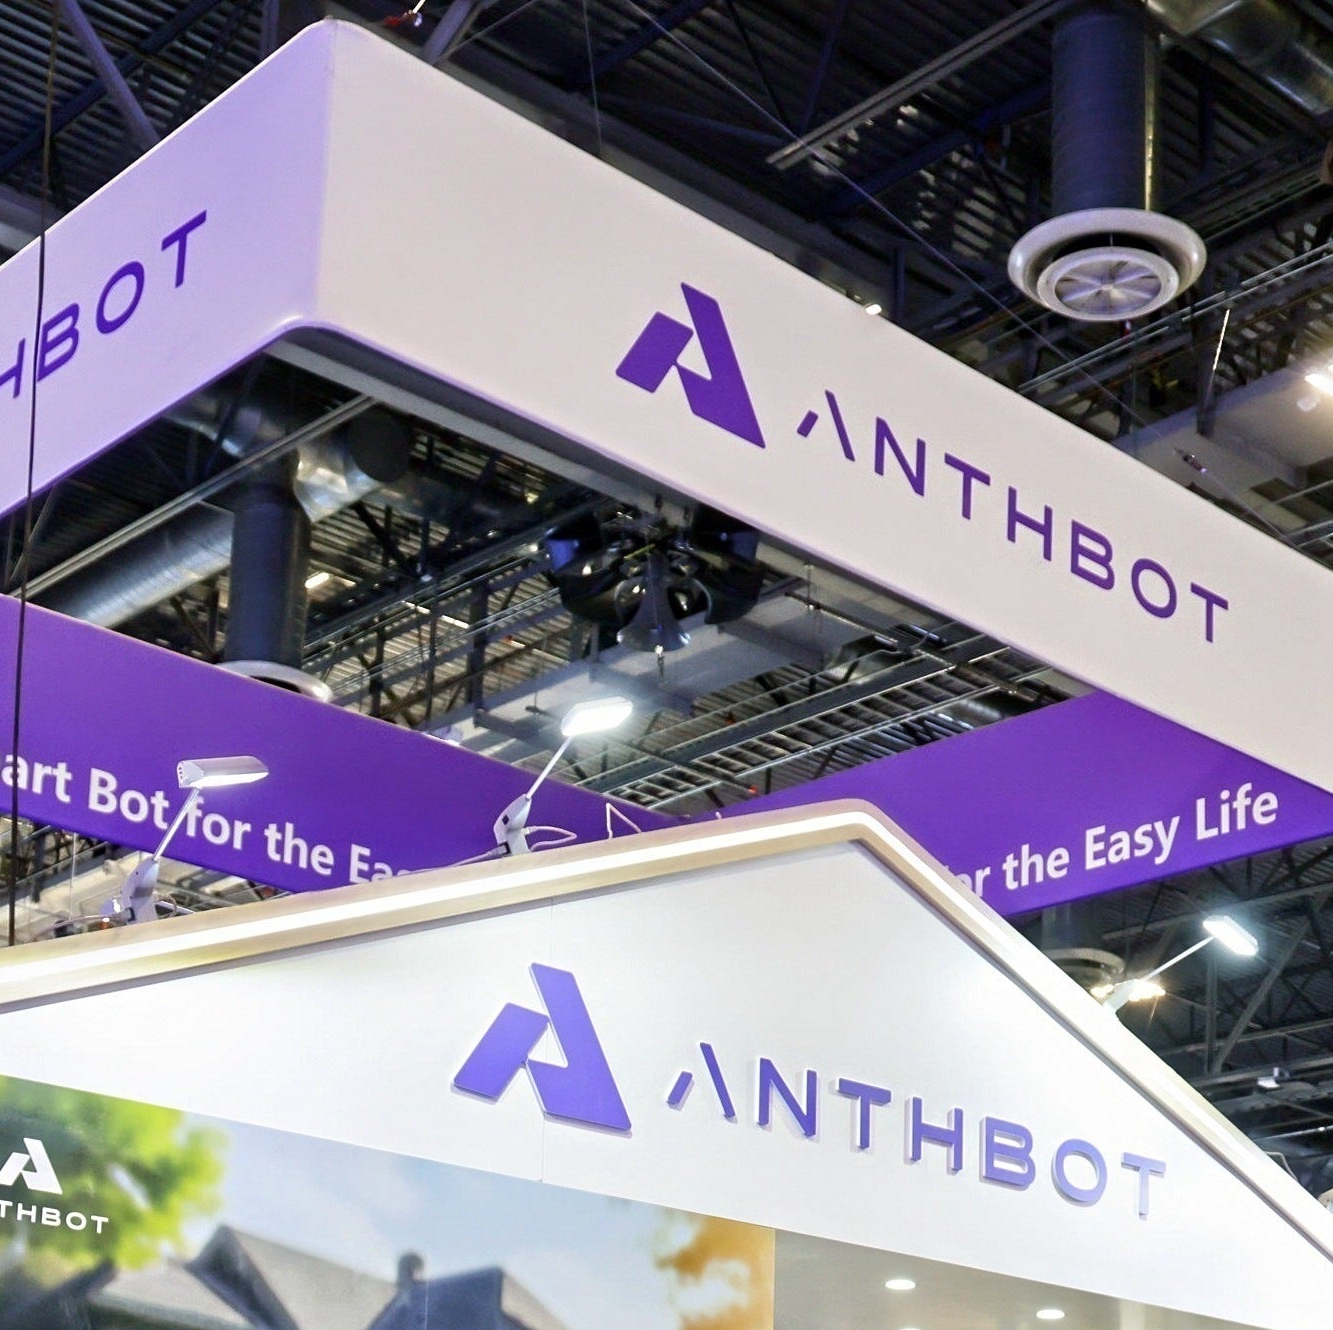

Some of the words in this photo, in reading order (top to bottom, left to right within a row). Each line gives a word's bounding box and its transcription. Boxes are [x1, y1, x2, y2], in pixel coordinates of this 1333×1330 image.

[797, 390, 1230, 643] ANTHBOT
[88, 767, 170, 829] Bot
[186, 796, 252, 850] for
[264, 821, 335, 877] the
[1001, 843, 1070, 891] the
[1084, 816, 1181, 871] Easy
[1196, 782, 1279, 841] Life
[667, 1041, 1166, 1219] ANTHBOT
